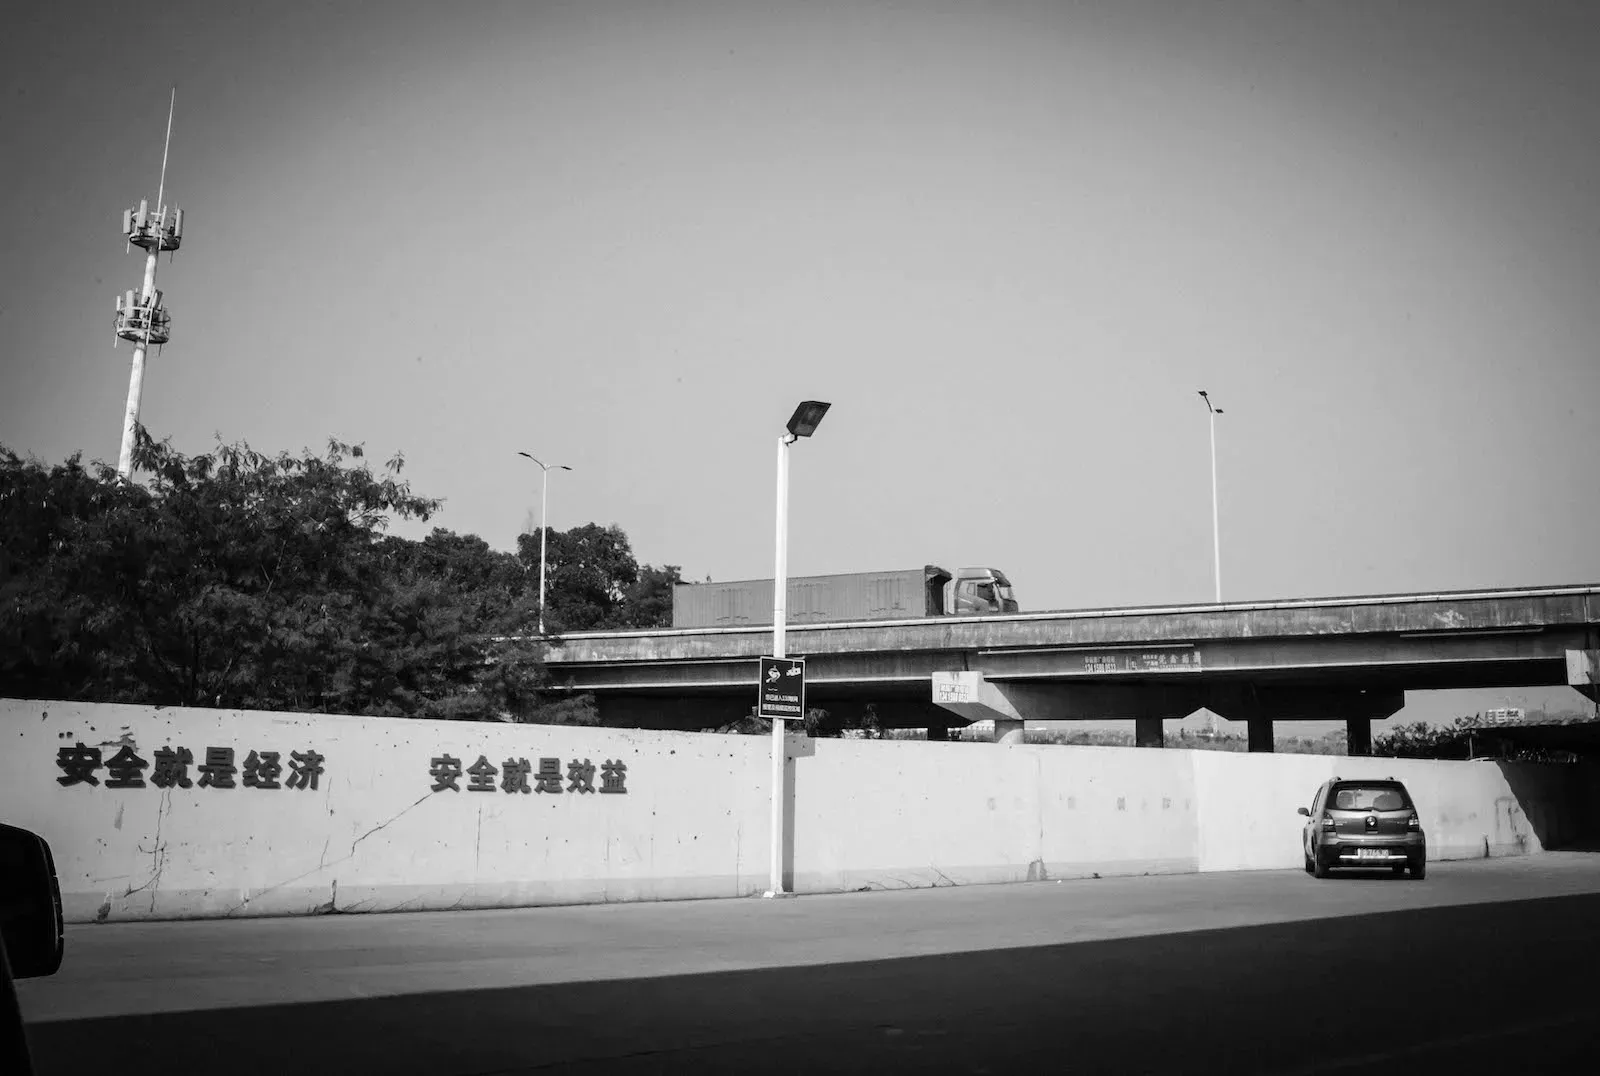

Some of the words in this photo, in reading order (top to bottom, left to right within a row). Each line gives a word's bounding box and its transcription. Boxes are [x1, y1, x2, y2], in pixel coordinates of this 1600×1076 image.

[56, 742, 325, 791] 安全就是经济
[429, 753, 627, 795] 安全就是效益
